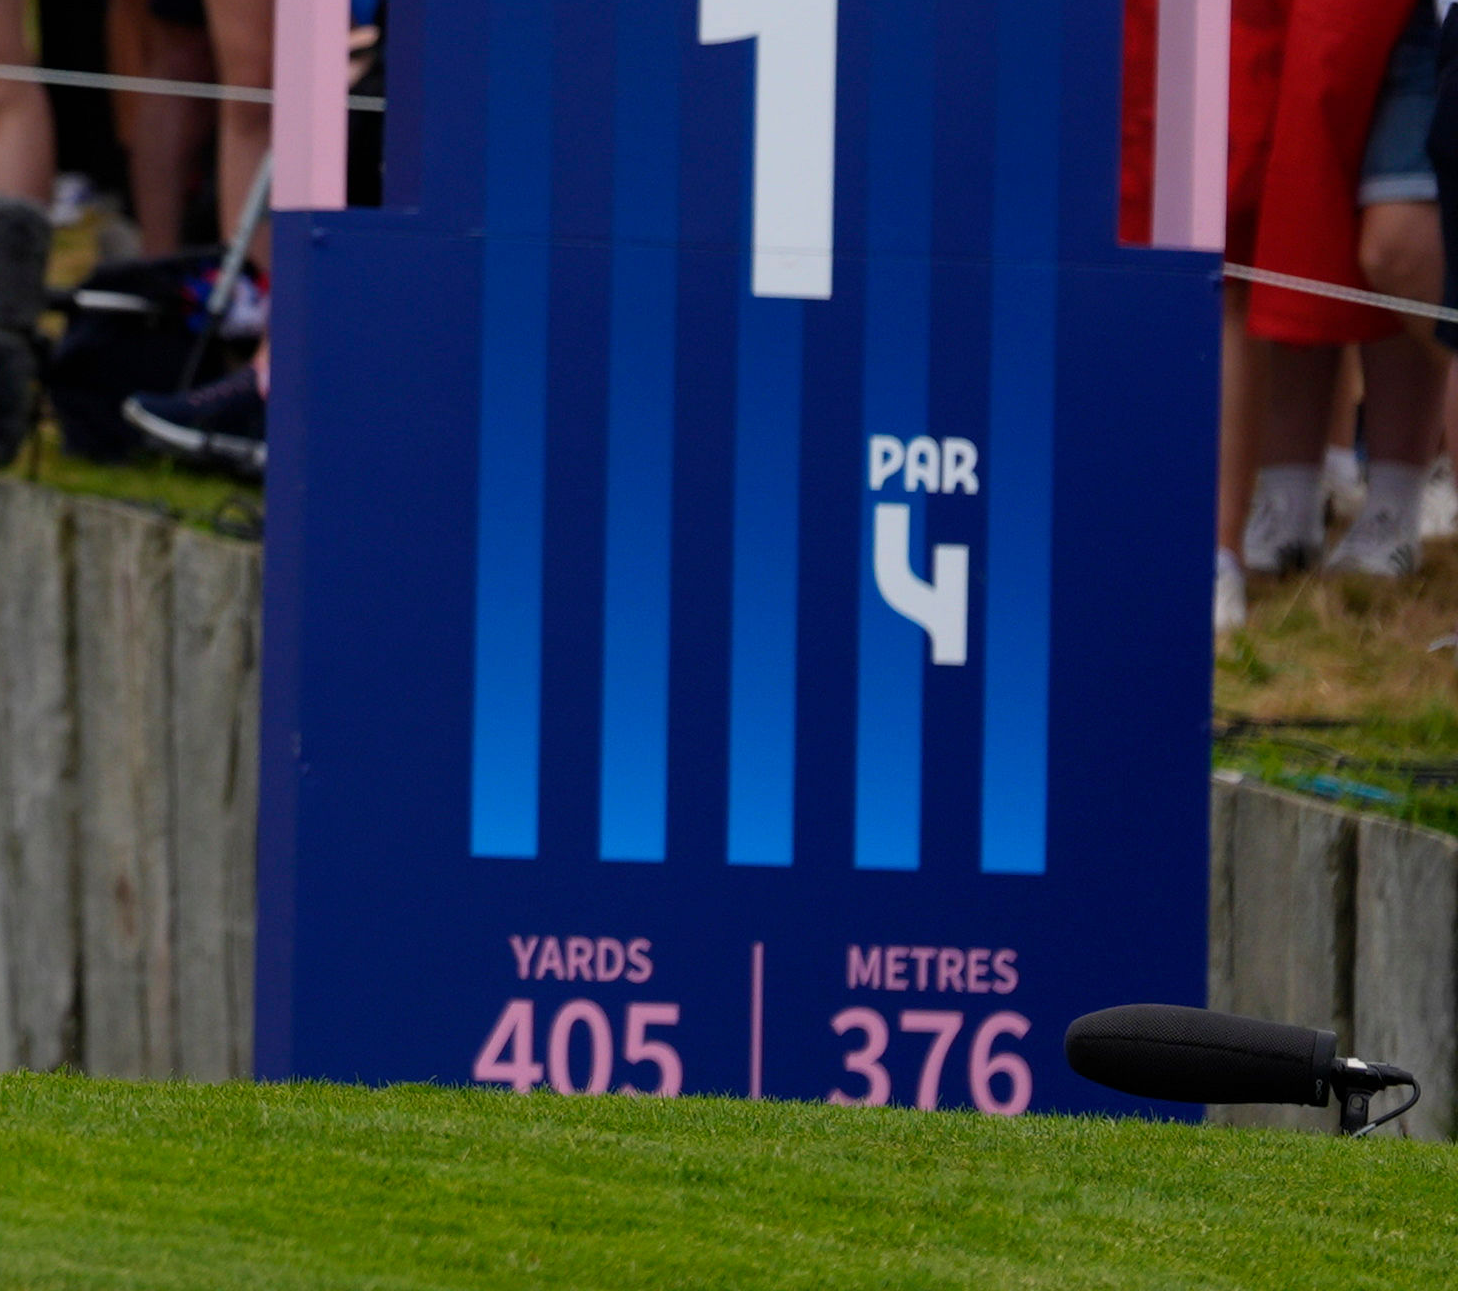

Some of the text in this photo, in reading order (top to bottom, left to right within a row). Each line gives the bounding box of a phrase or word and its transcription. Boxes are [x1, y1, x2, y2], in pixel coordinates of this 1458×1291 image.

[869, 434, 980, 495] PAR
[874, 503, 970, 666] 4
[510, 935, 1020, 994] YARDS METRES
[474, 998, 1033, 1117] 405 376
